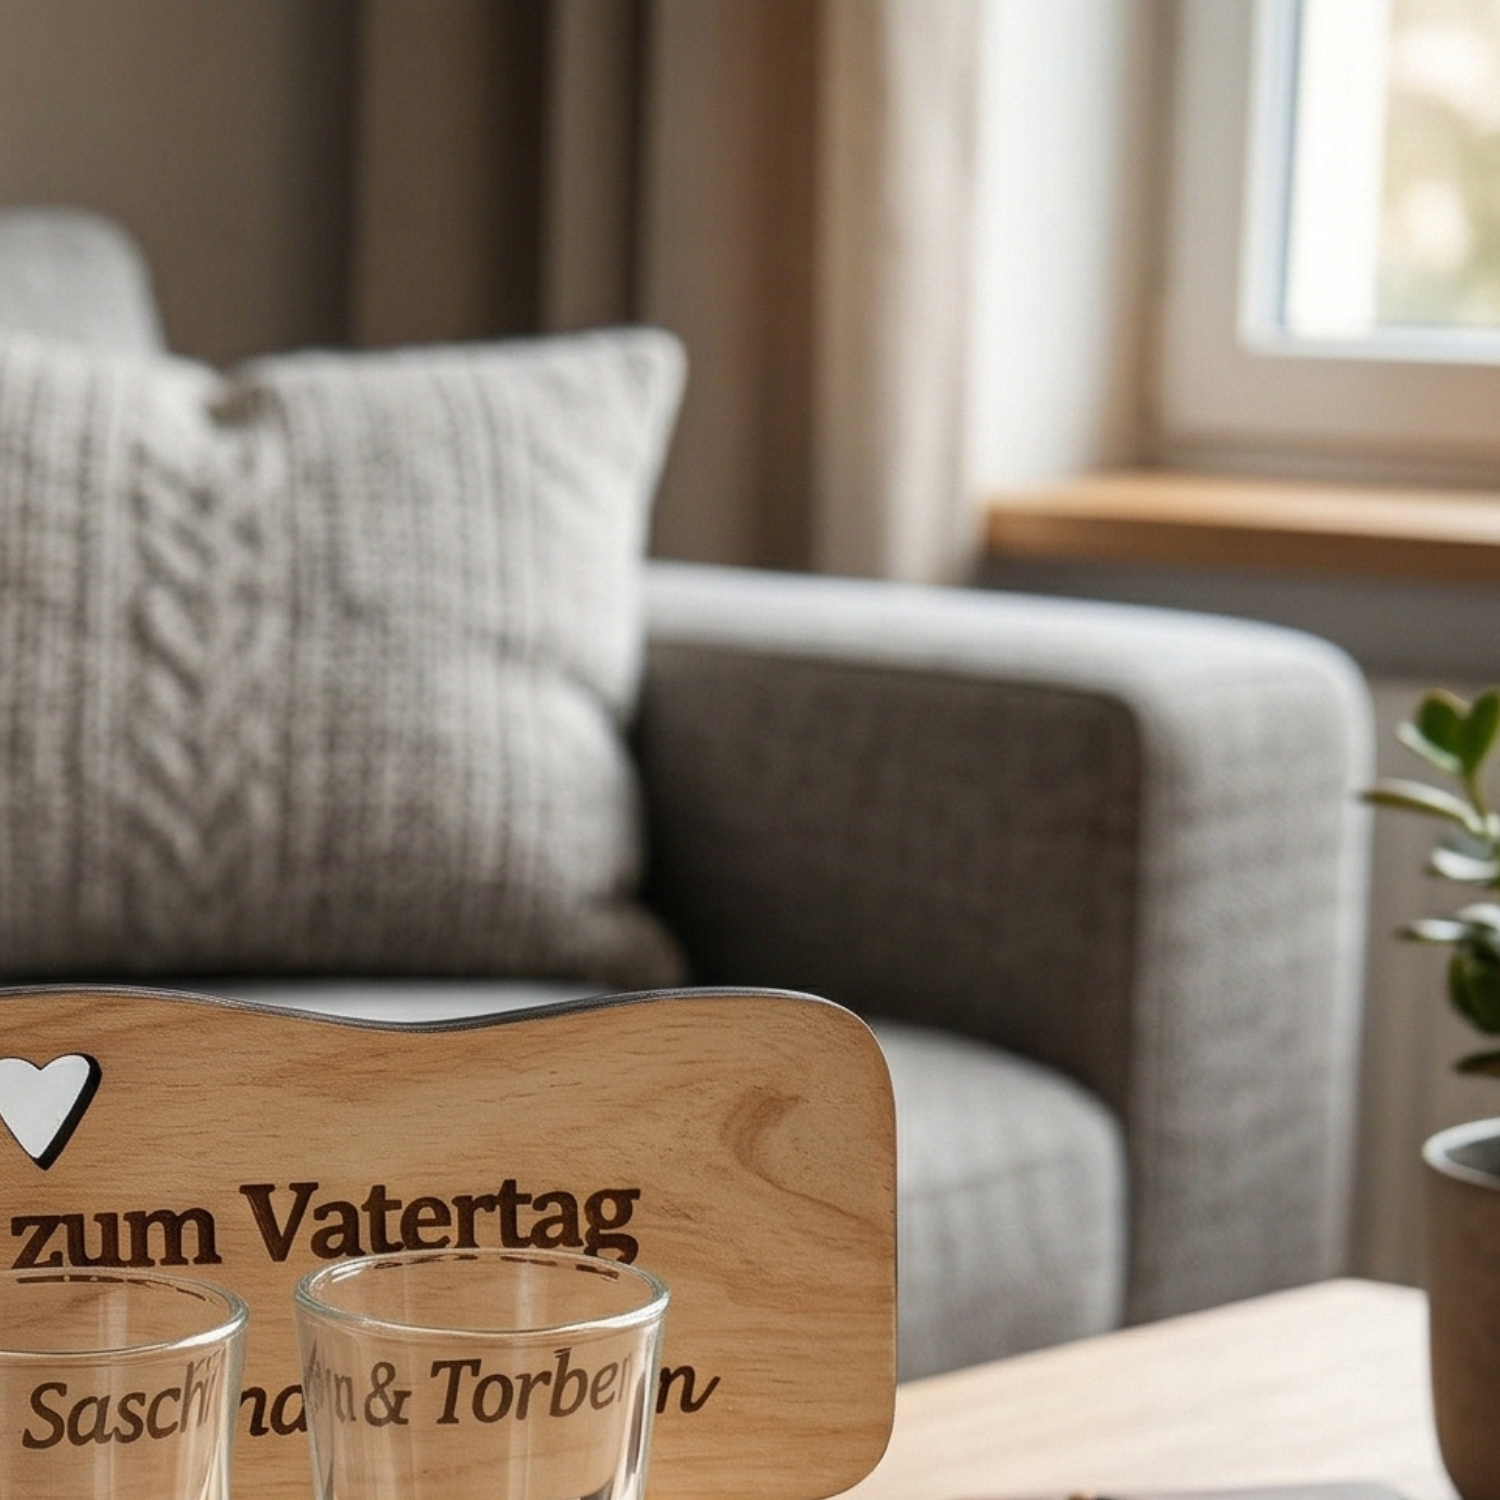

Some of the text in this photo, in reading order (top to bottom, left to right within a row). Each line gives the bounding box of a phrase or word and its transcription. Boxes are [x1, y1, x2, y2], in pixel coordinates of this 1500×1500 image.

[10, 1207, 223, 1270] zum
[239, 1178, 642, 1266] Vatertag
[363, 1360, 413, 1428] &
